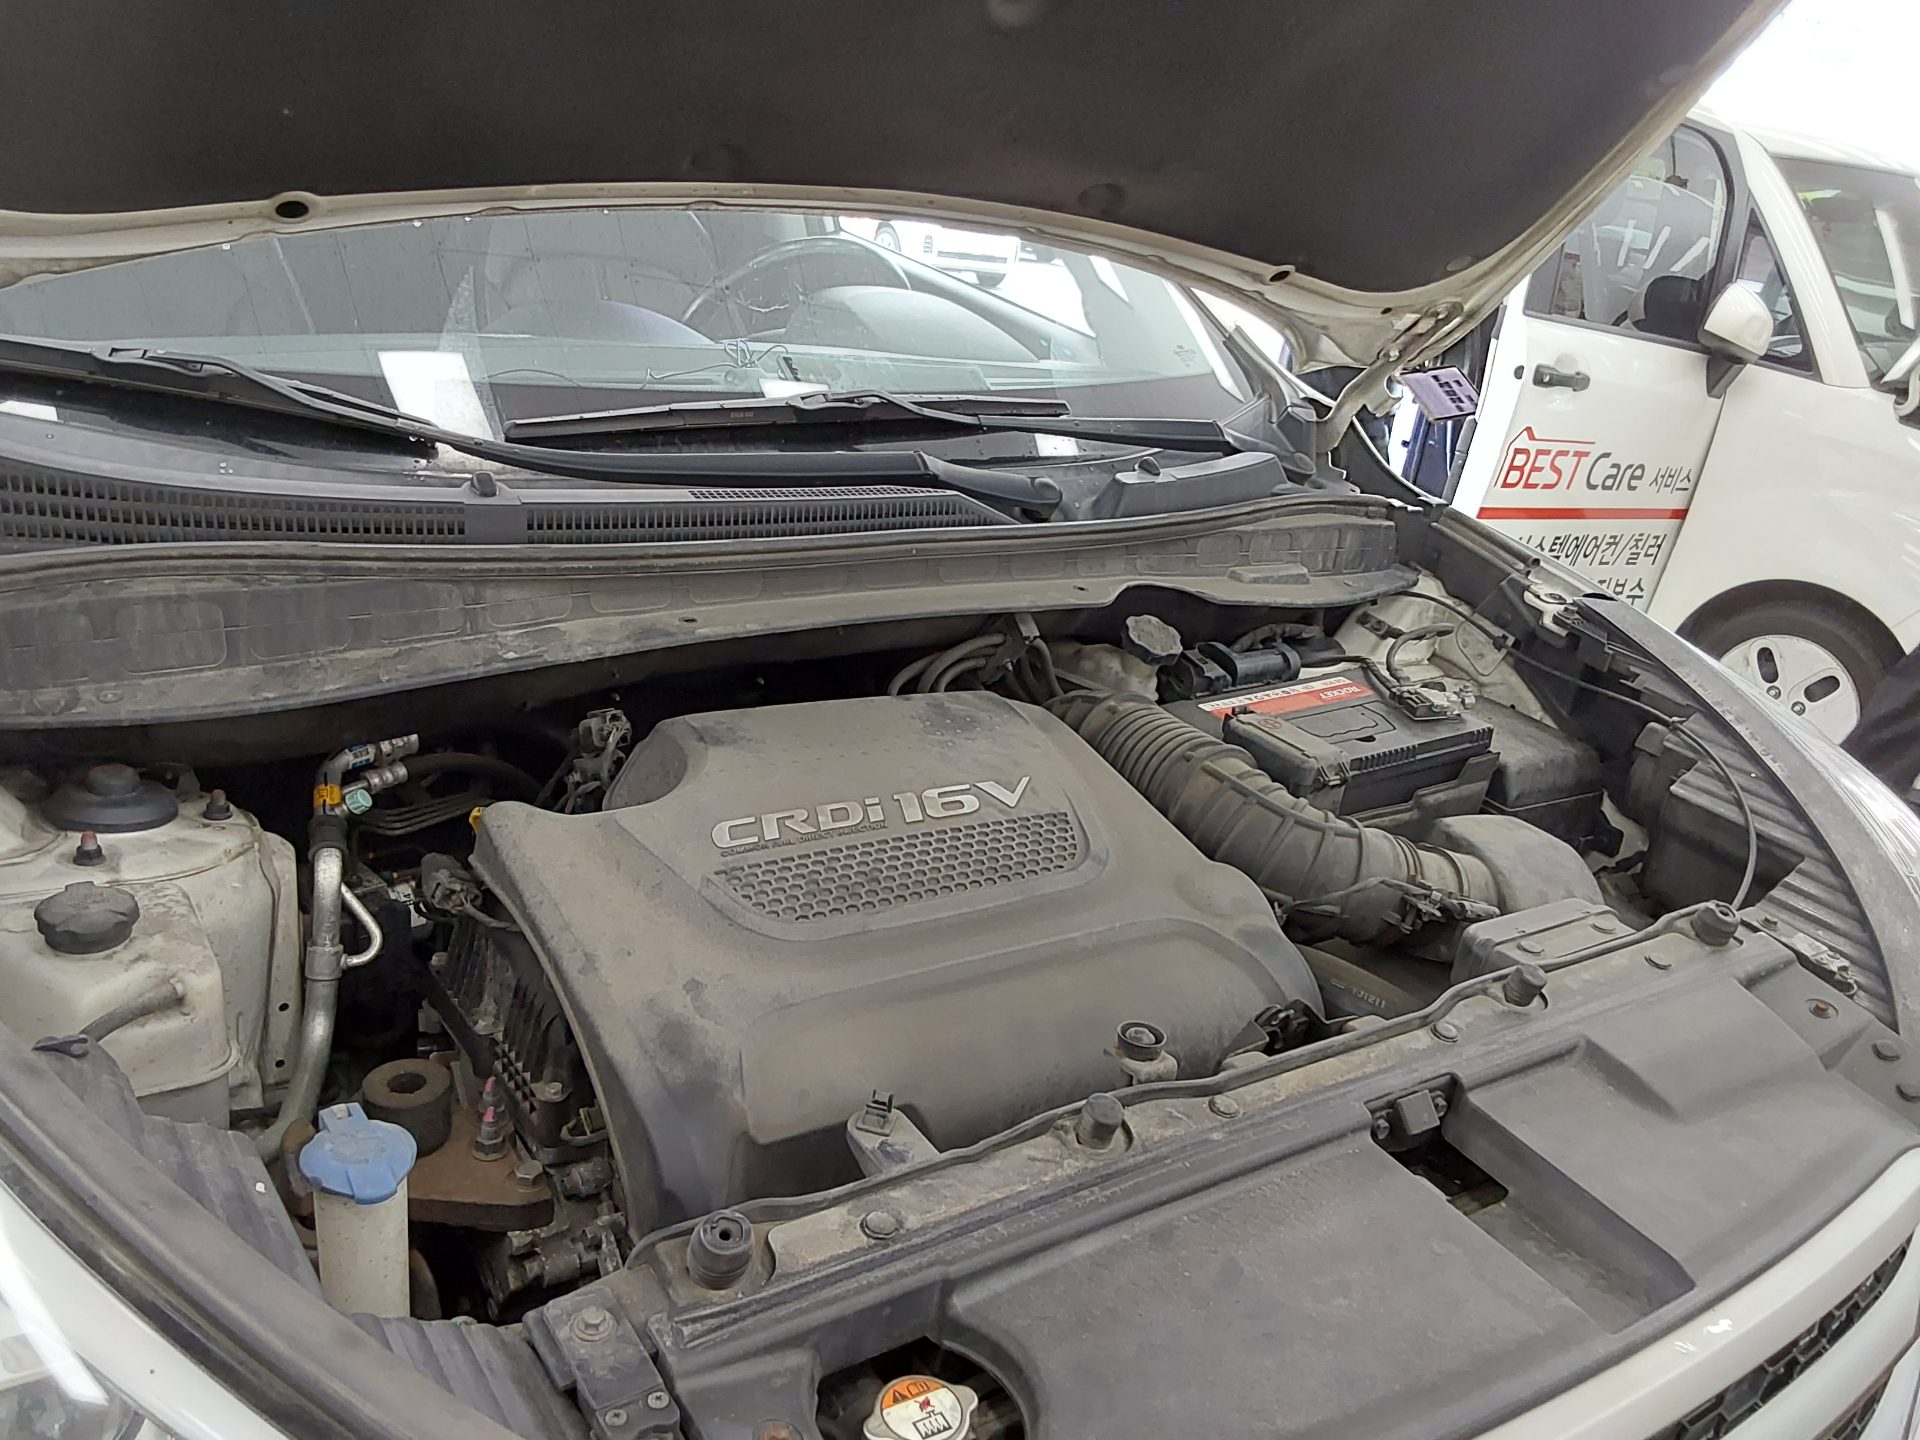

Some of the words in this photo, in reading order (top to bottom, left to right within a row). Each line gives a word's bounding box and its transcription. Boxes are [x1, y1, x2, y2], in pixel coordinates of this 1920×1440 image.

[1501, 448, 1591, 490] BEST
[1585, 452, 1646, 491] Care
[1649, 466, 1693, 494] 서비스
[1519, 532, 1668, 567] 스템에어컨/칠러
[1319, 685, 1362, 700] ROCKET
[711, 797, 886, 850] CRDi
[892, 775, 1031, 824] 16V
